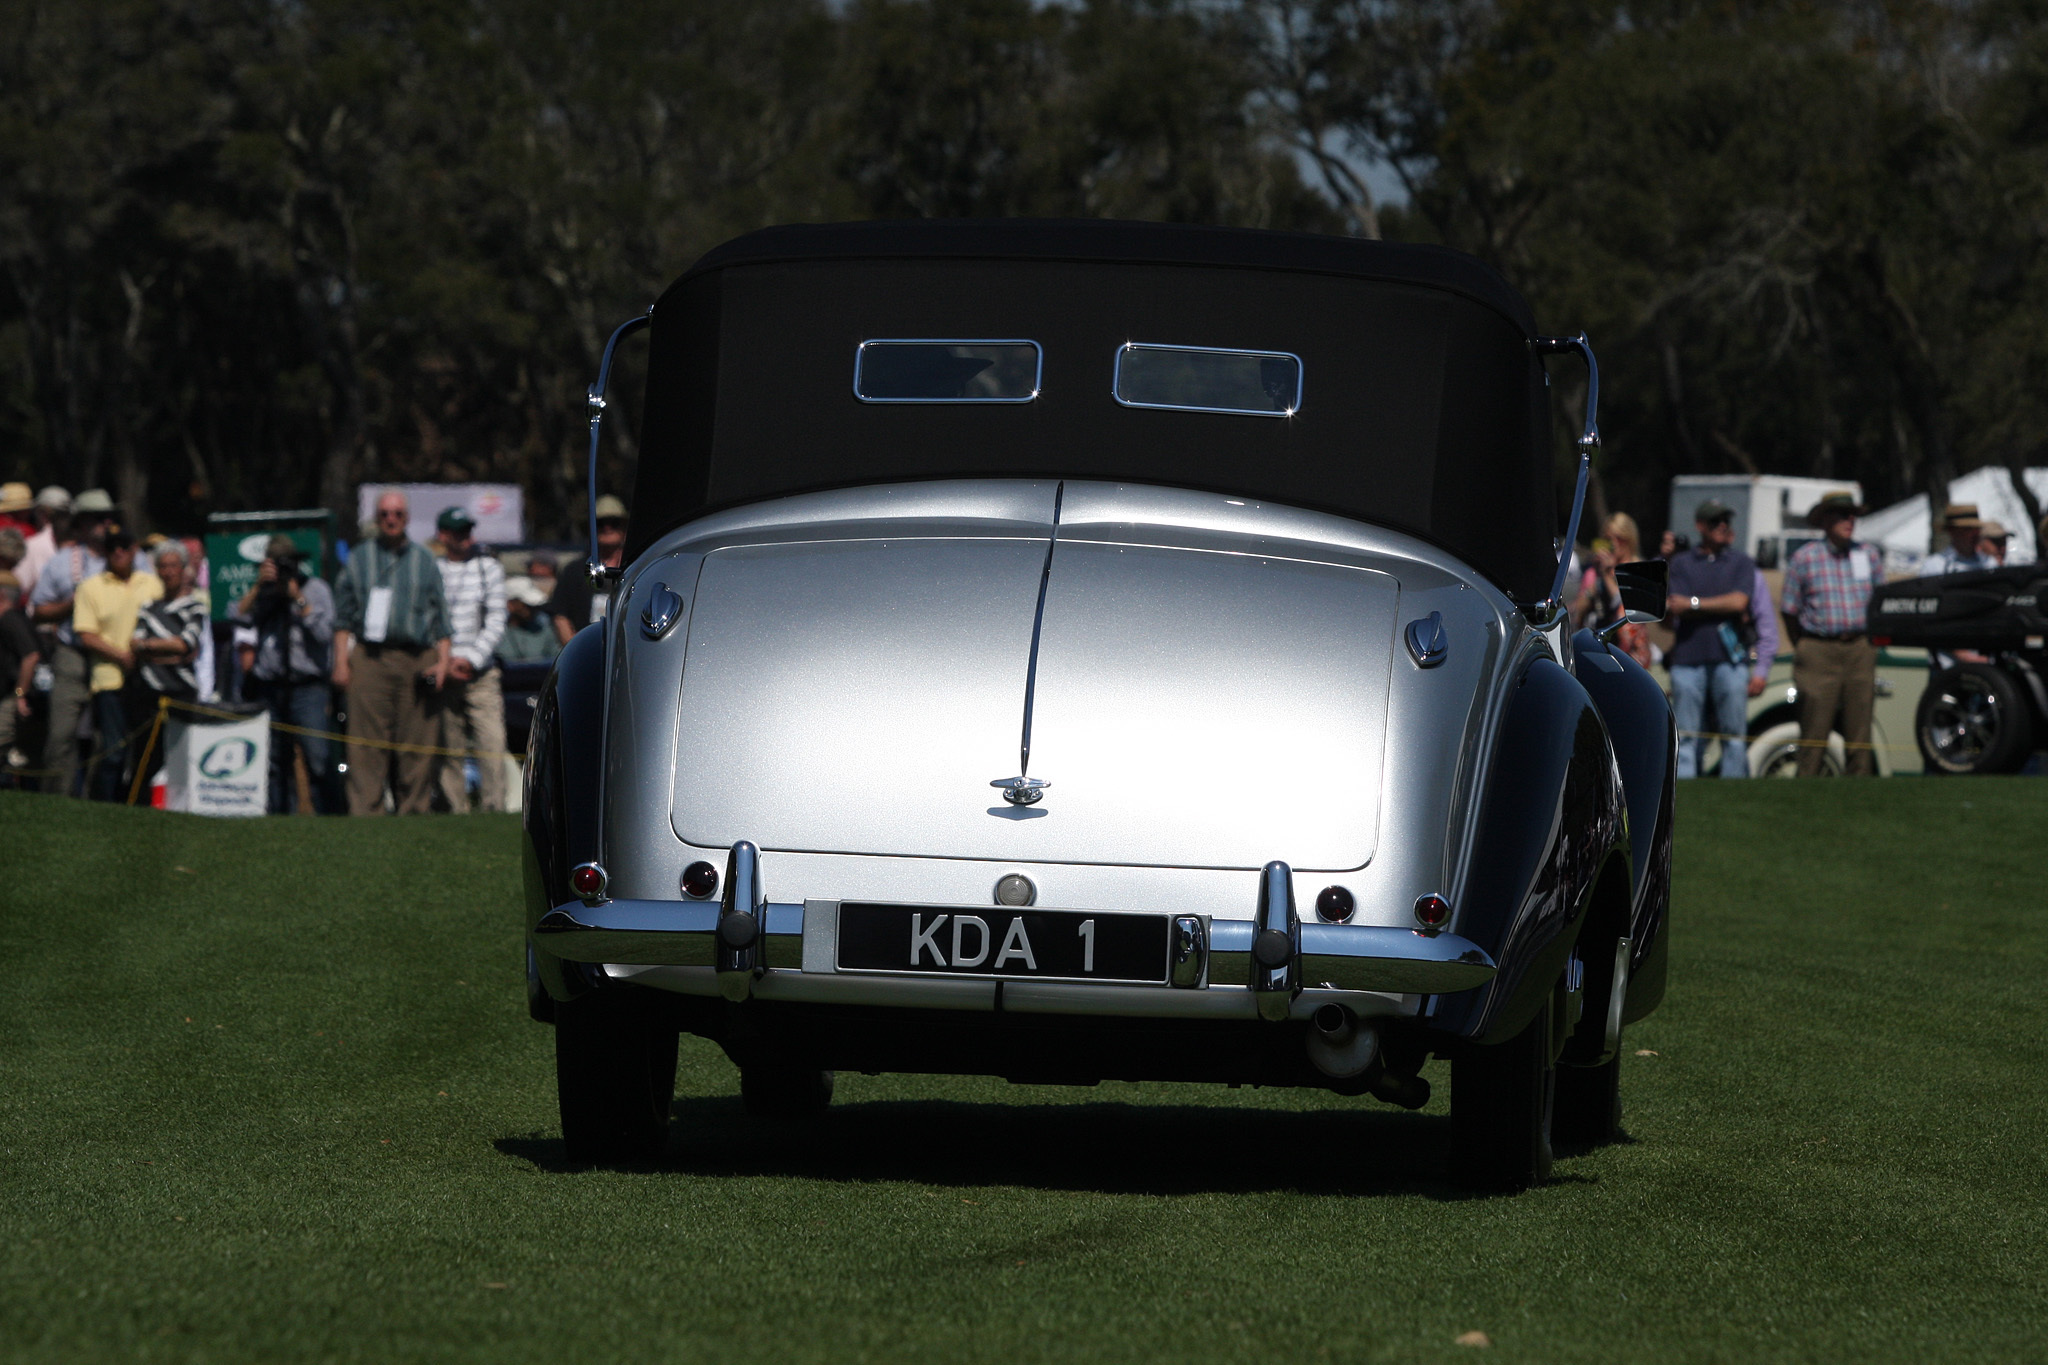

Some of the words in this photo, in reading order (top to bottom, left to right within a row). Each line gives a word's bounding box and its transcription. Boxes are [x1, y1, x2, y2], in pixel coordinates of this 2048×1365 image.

[1880, 598, 1918, 614] ARCTIC
[1918, 598, 1940, 614] CAT
[909, 912, 1037, 971] KDA
[1078, 918, 1095, 972] 1
